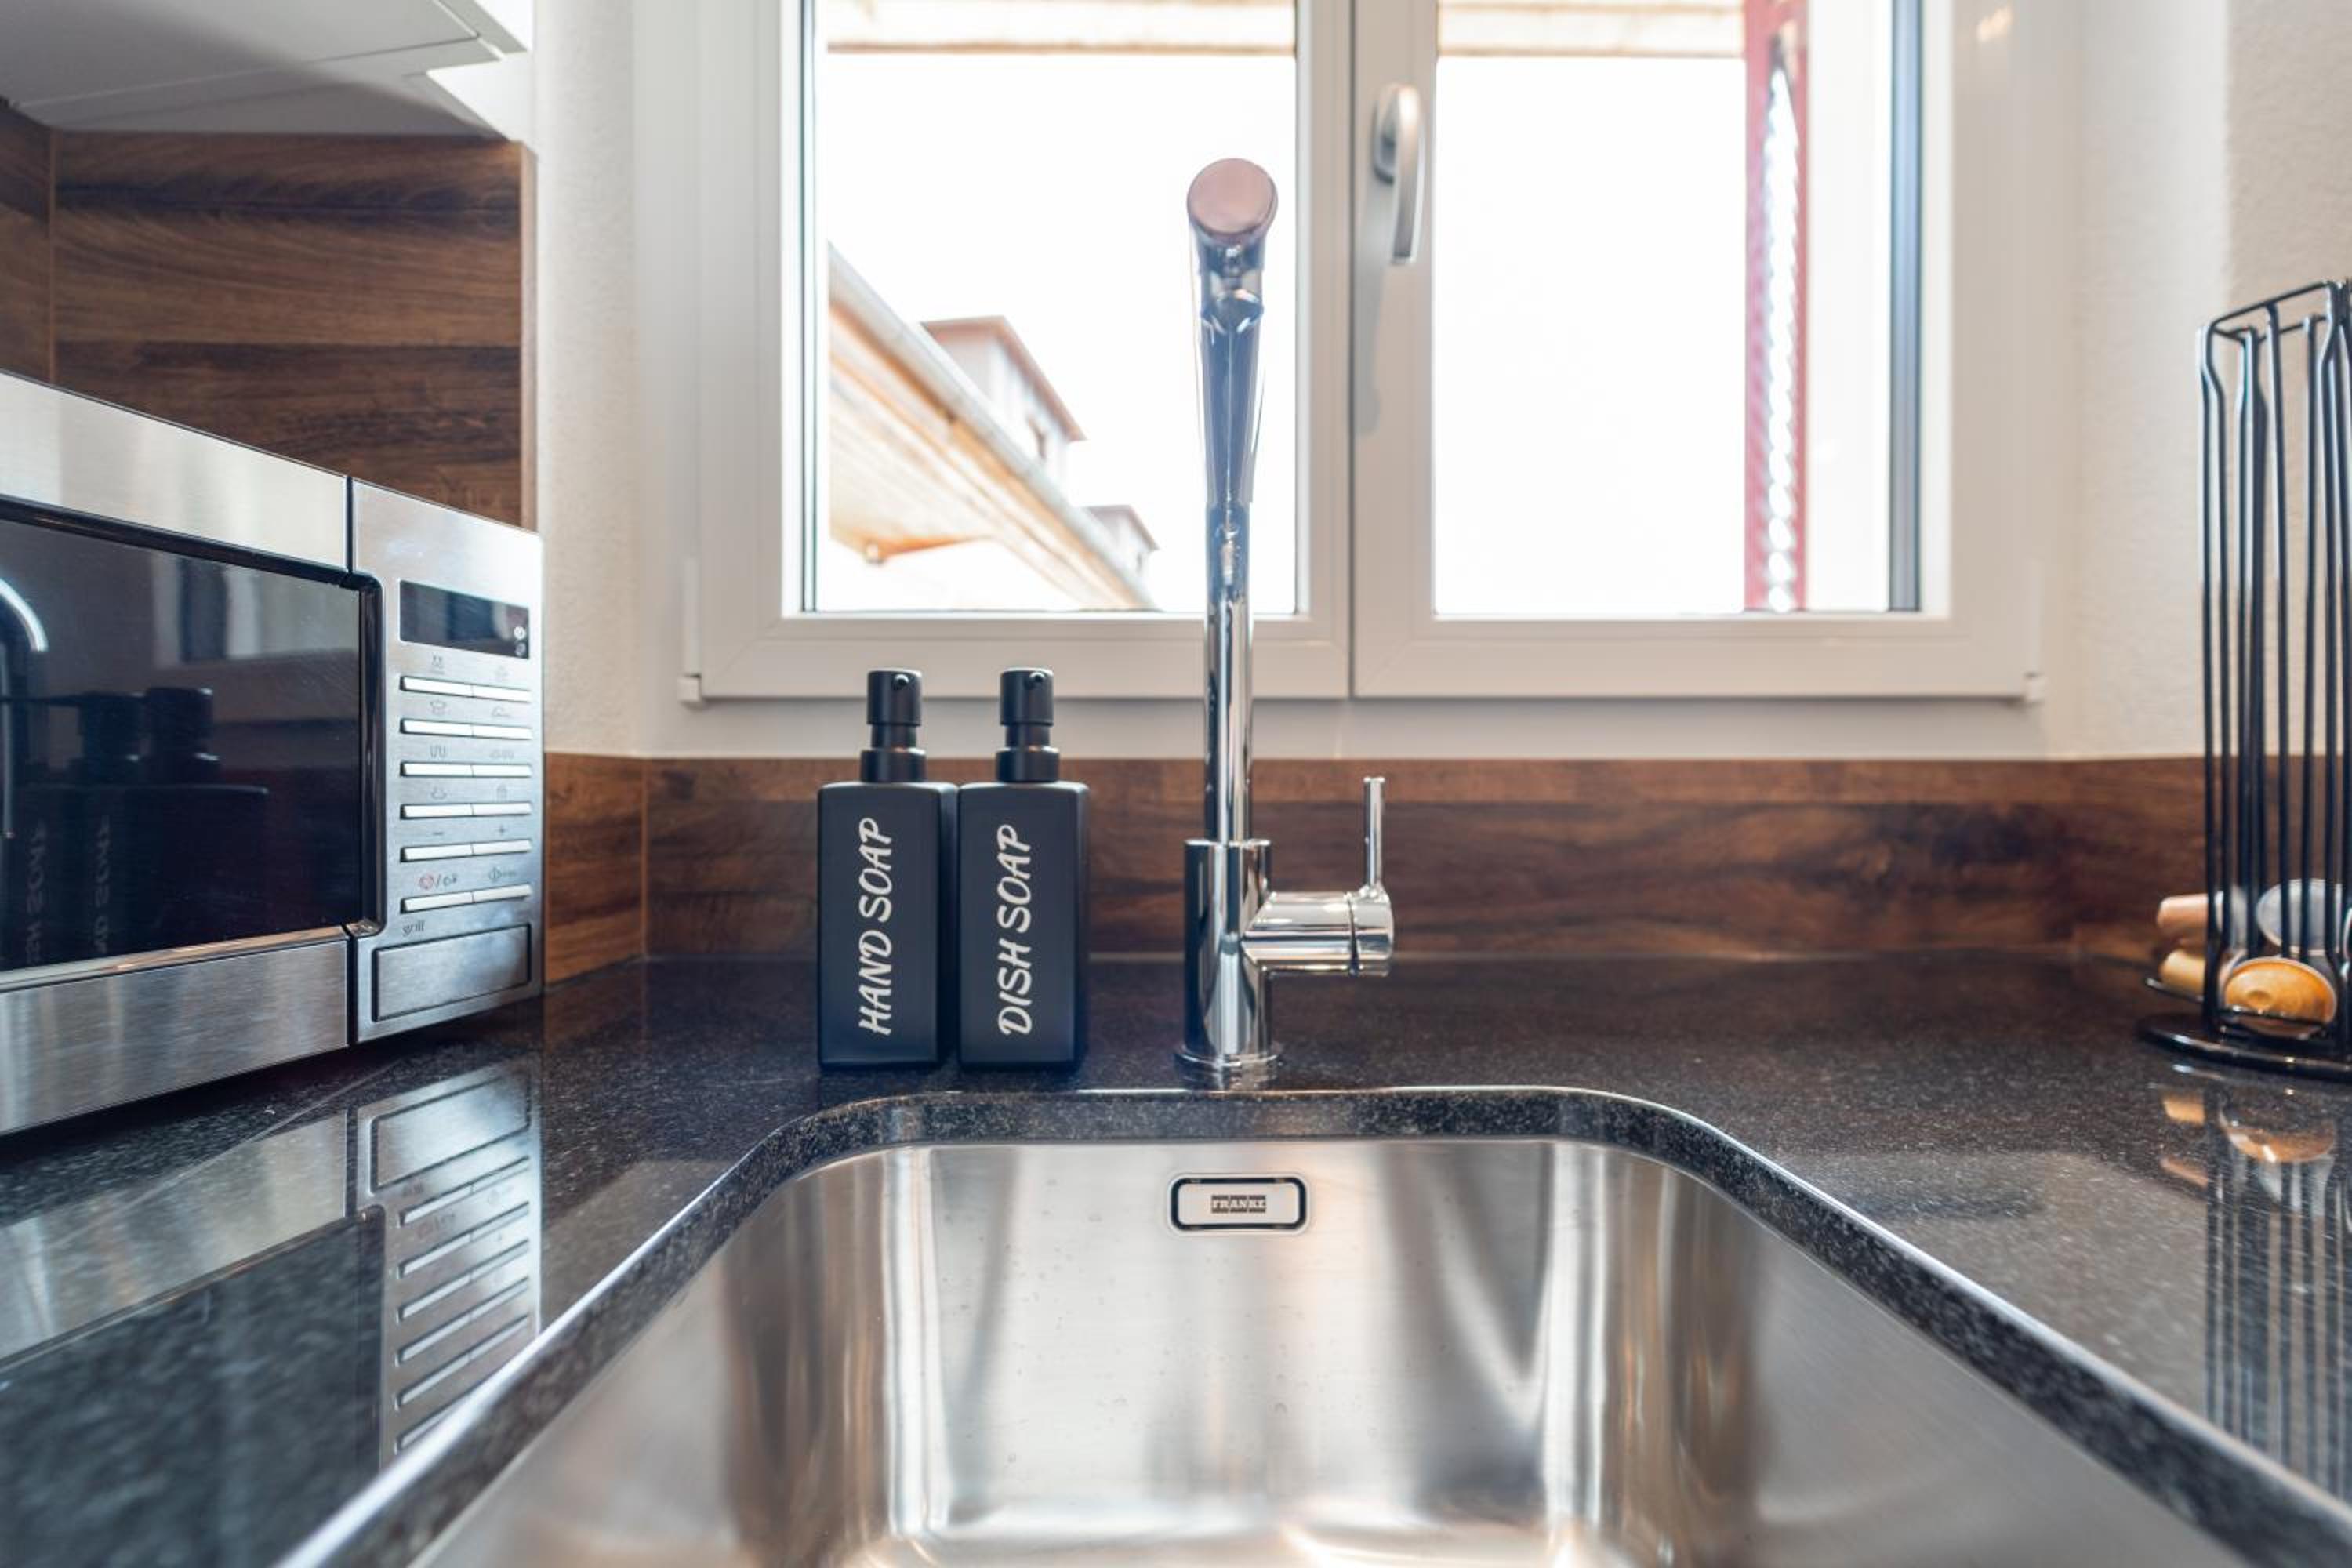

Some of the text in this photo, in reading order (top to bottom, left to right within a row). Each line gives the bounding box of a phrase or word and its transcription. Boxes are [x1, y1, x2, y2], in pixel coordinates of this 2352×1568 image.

[858, 817, 892, 1036] HAND SOAP
[996, 824, 1032, 1035] DISH SOAP
